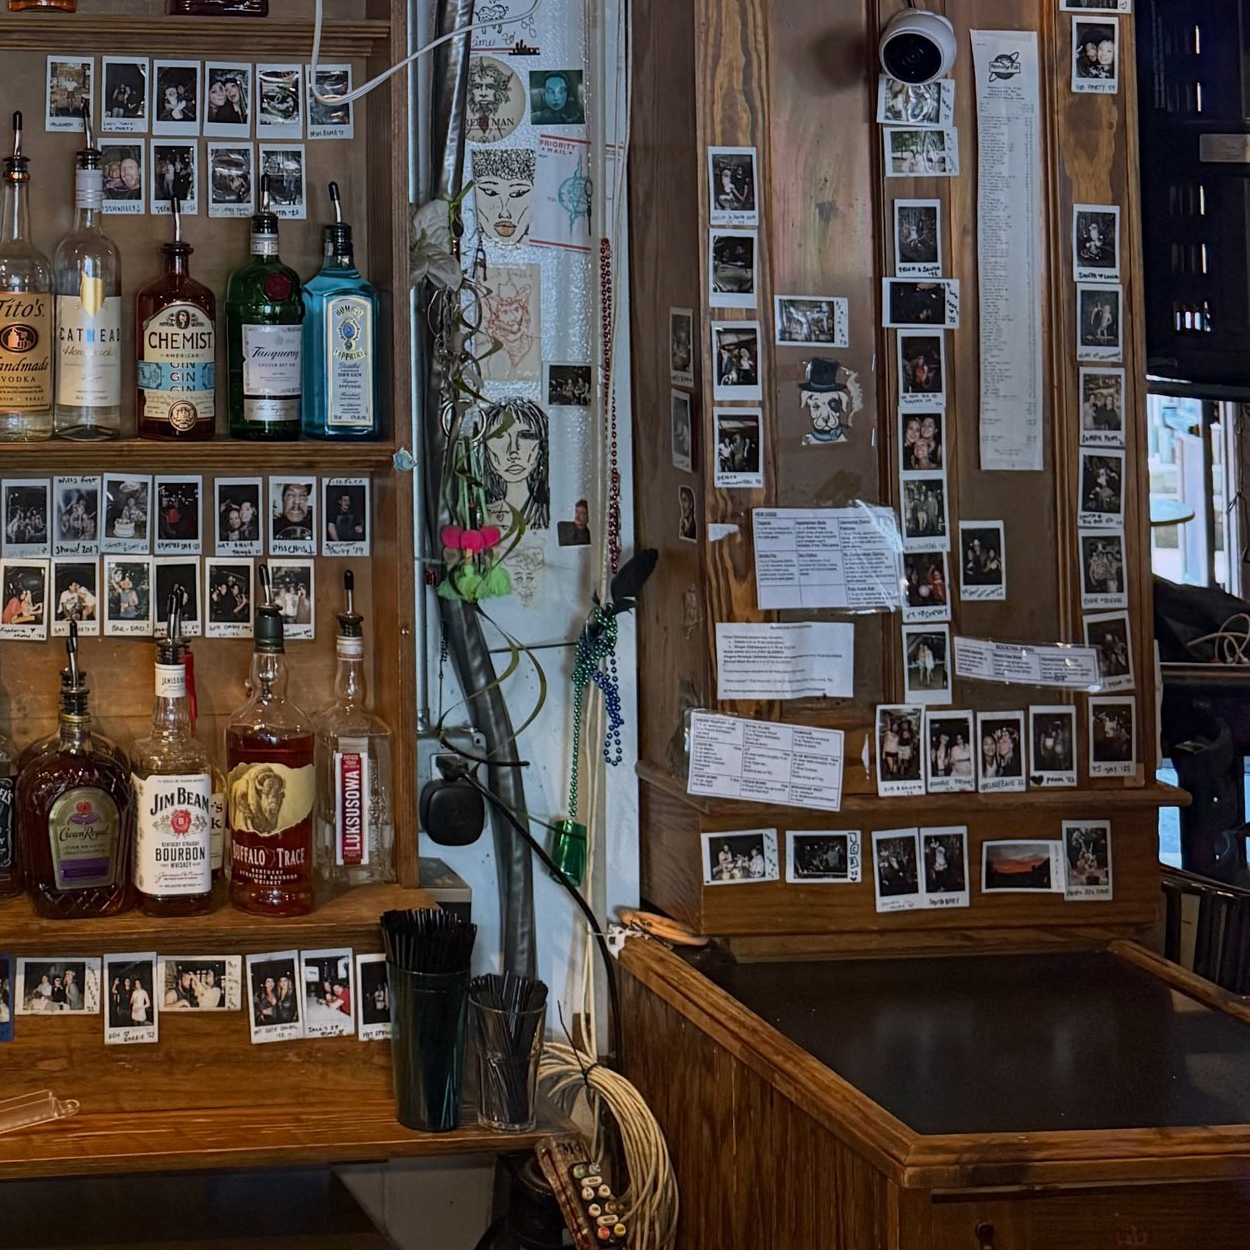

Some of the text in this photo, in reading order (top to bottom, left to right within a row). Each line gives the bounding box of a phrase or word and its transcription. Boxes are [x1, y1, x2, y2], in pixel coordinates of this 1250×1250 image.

[492, 117, 514, 127] MAN
[539, 139, 577, 151] PRIORITY
[148, 332, 212, 350] CHEMIST
[252, 346, 299, 364] Tanqueray
[1, 375, 36, 384] VODKA
[170, 372, 196, 383] GIN
[150, 787, 209, 816] JIM BEAM
[345, 771, 360, 851] LUKSUSOWA
[155, 847, 205, 861] BOURBON
[232, 843, 305, 868] BUFFALO TRACE
